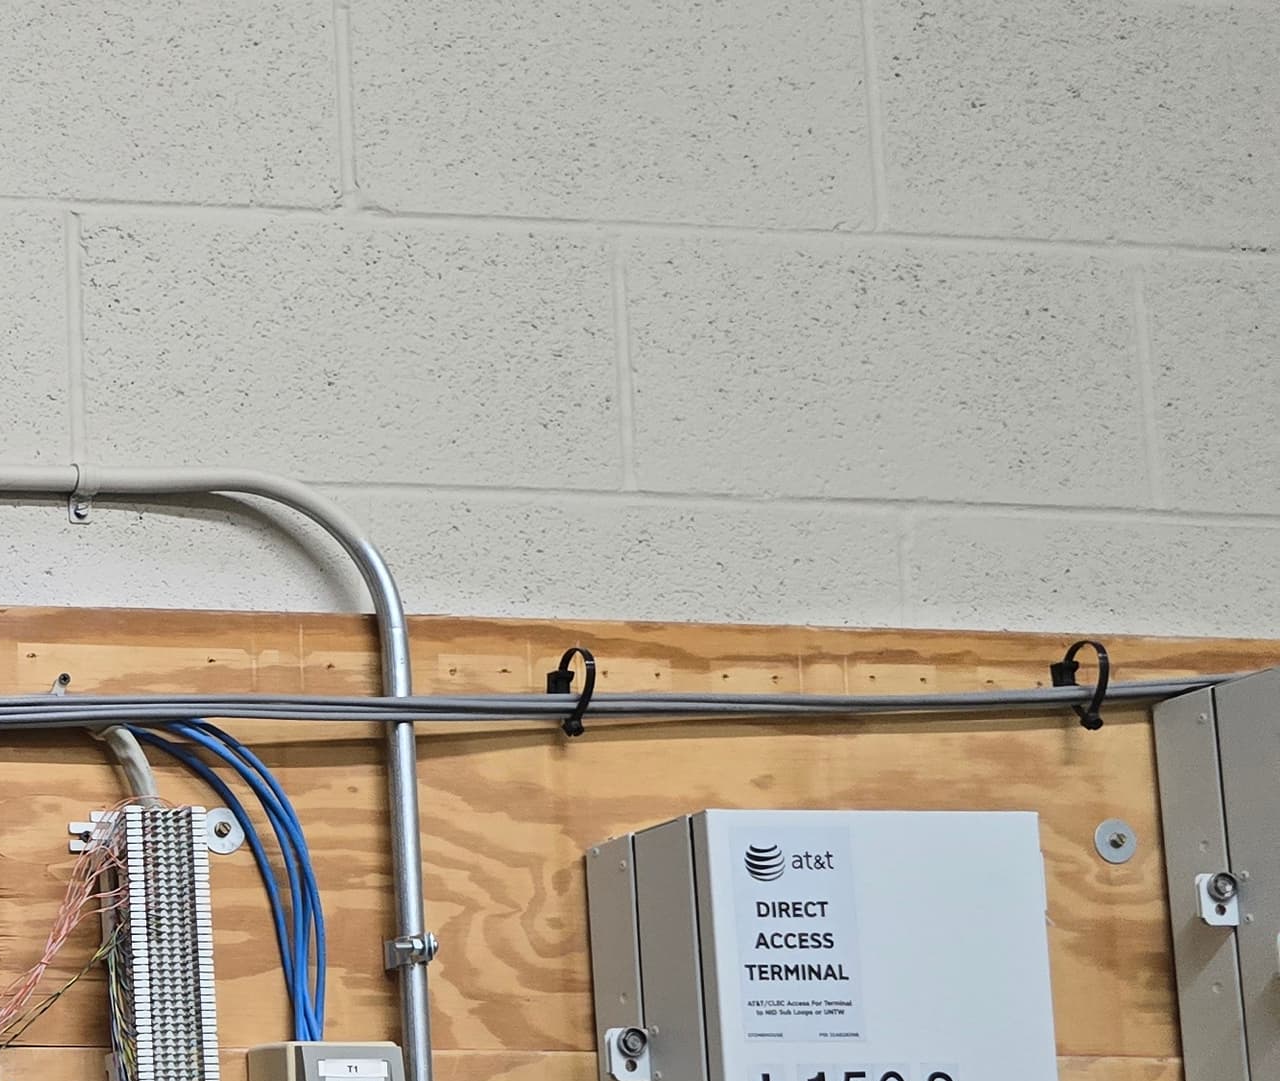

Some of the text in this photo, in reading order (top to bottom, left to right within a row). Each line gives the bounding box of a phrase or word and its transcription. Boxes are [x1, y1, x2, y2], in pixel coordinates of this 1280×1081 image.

[791, 851, 835, 870] at&t
[755, 901, 829, 918] DIRECT
[755, 932, 835, 949] ACCESS
[744, 964, 850, 981] TERMINAL
[347, 1065, 358, 1073] T1
